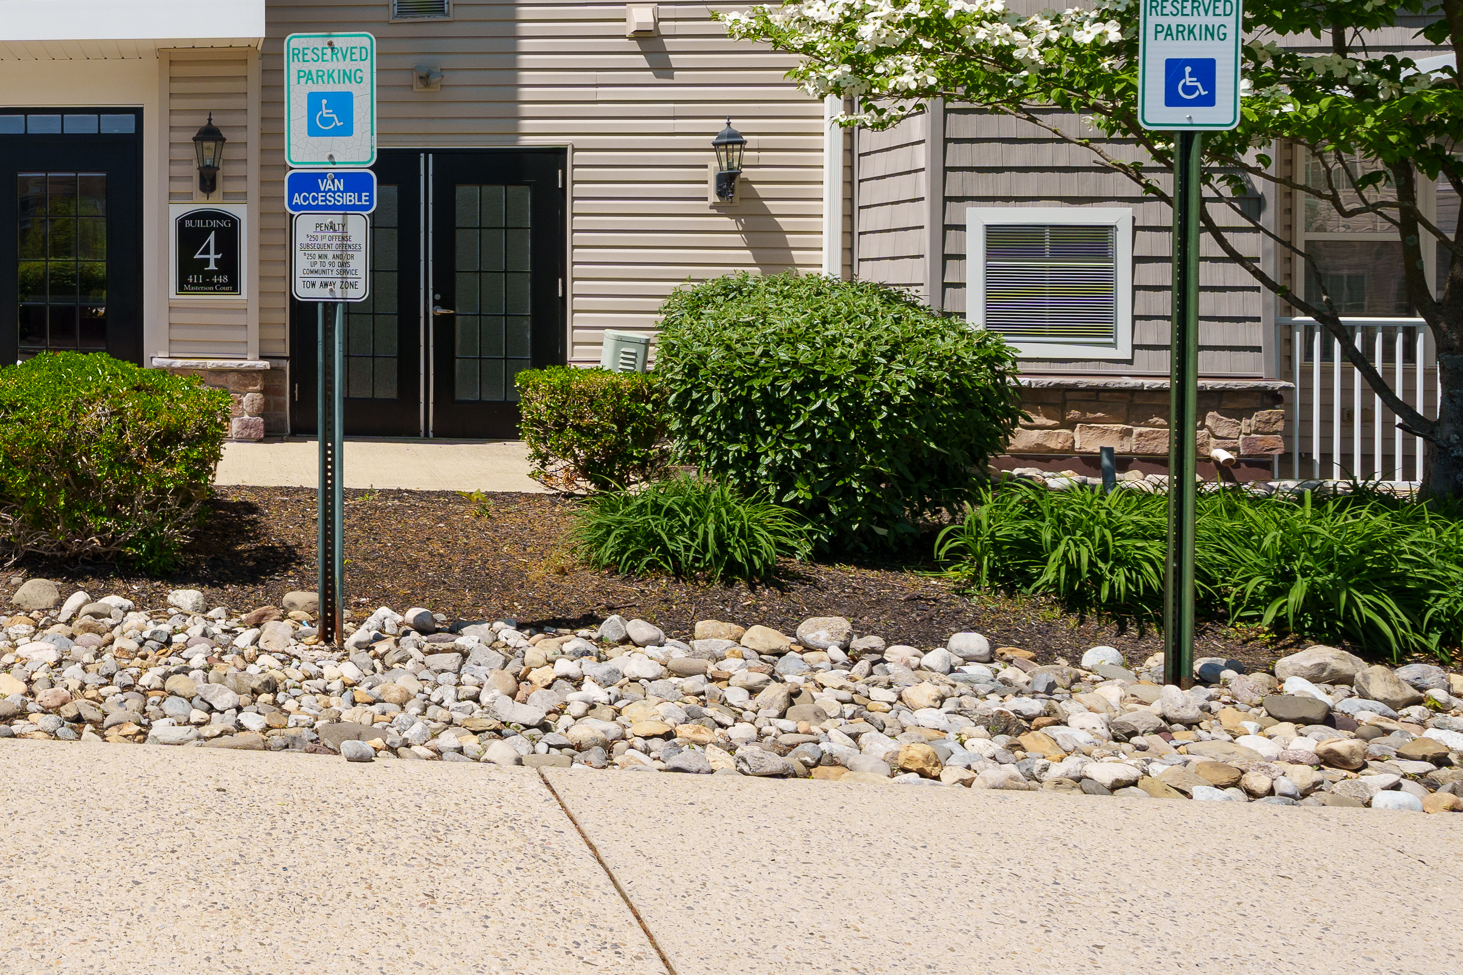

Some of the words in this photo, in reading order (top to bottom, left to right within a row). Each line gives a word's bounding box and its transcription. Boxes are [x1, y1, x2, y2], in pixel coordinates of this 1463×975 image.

[1149, 0, 1234, 17] RESERVED
[1154, 23, 1228, 41] PARKING
[291, 46, 369, 63] RESERVED
[297, 68, 364, 85] PARKING
[318, 178, 344, 192] VAN
[292, 192, 370, 206] ACCESSIBLE
[184, 219, 231, 228] BUILDING
[315, 222, 346, 232] PENALTY
[306, 233, 319, 242] $250
[327, 234, 353, 242] OFFENSE
[193, 230, 223, 271] 4
[299, 242, 334, 250] SUBSEQUENT
[334, 242, 362, 250] OFFENSES
[303, 252, 317, 260] $250
[317, 253, 330, 261] MIN.
[331, 253, 355, 261] AND/OR
[302, 268, 335, 276] COMMUNITY
[335, 268, 359, 276] SERVICE
[187, 274, 203, 283] 411
[211, 274, 229, 283] 448
[302, 280, 317, 290] TOW
[318, 280, 337, 290] AWAY
[339, 280, 359, 290] ZONE
